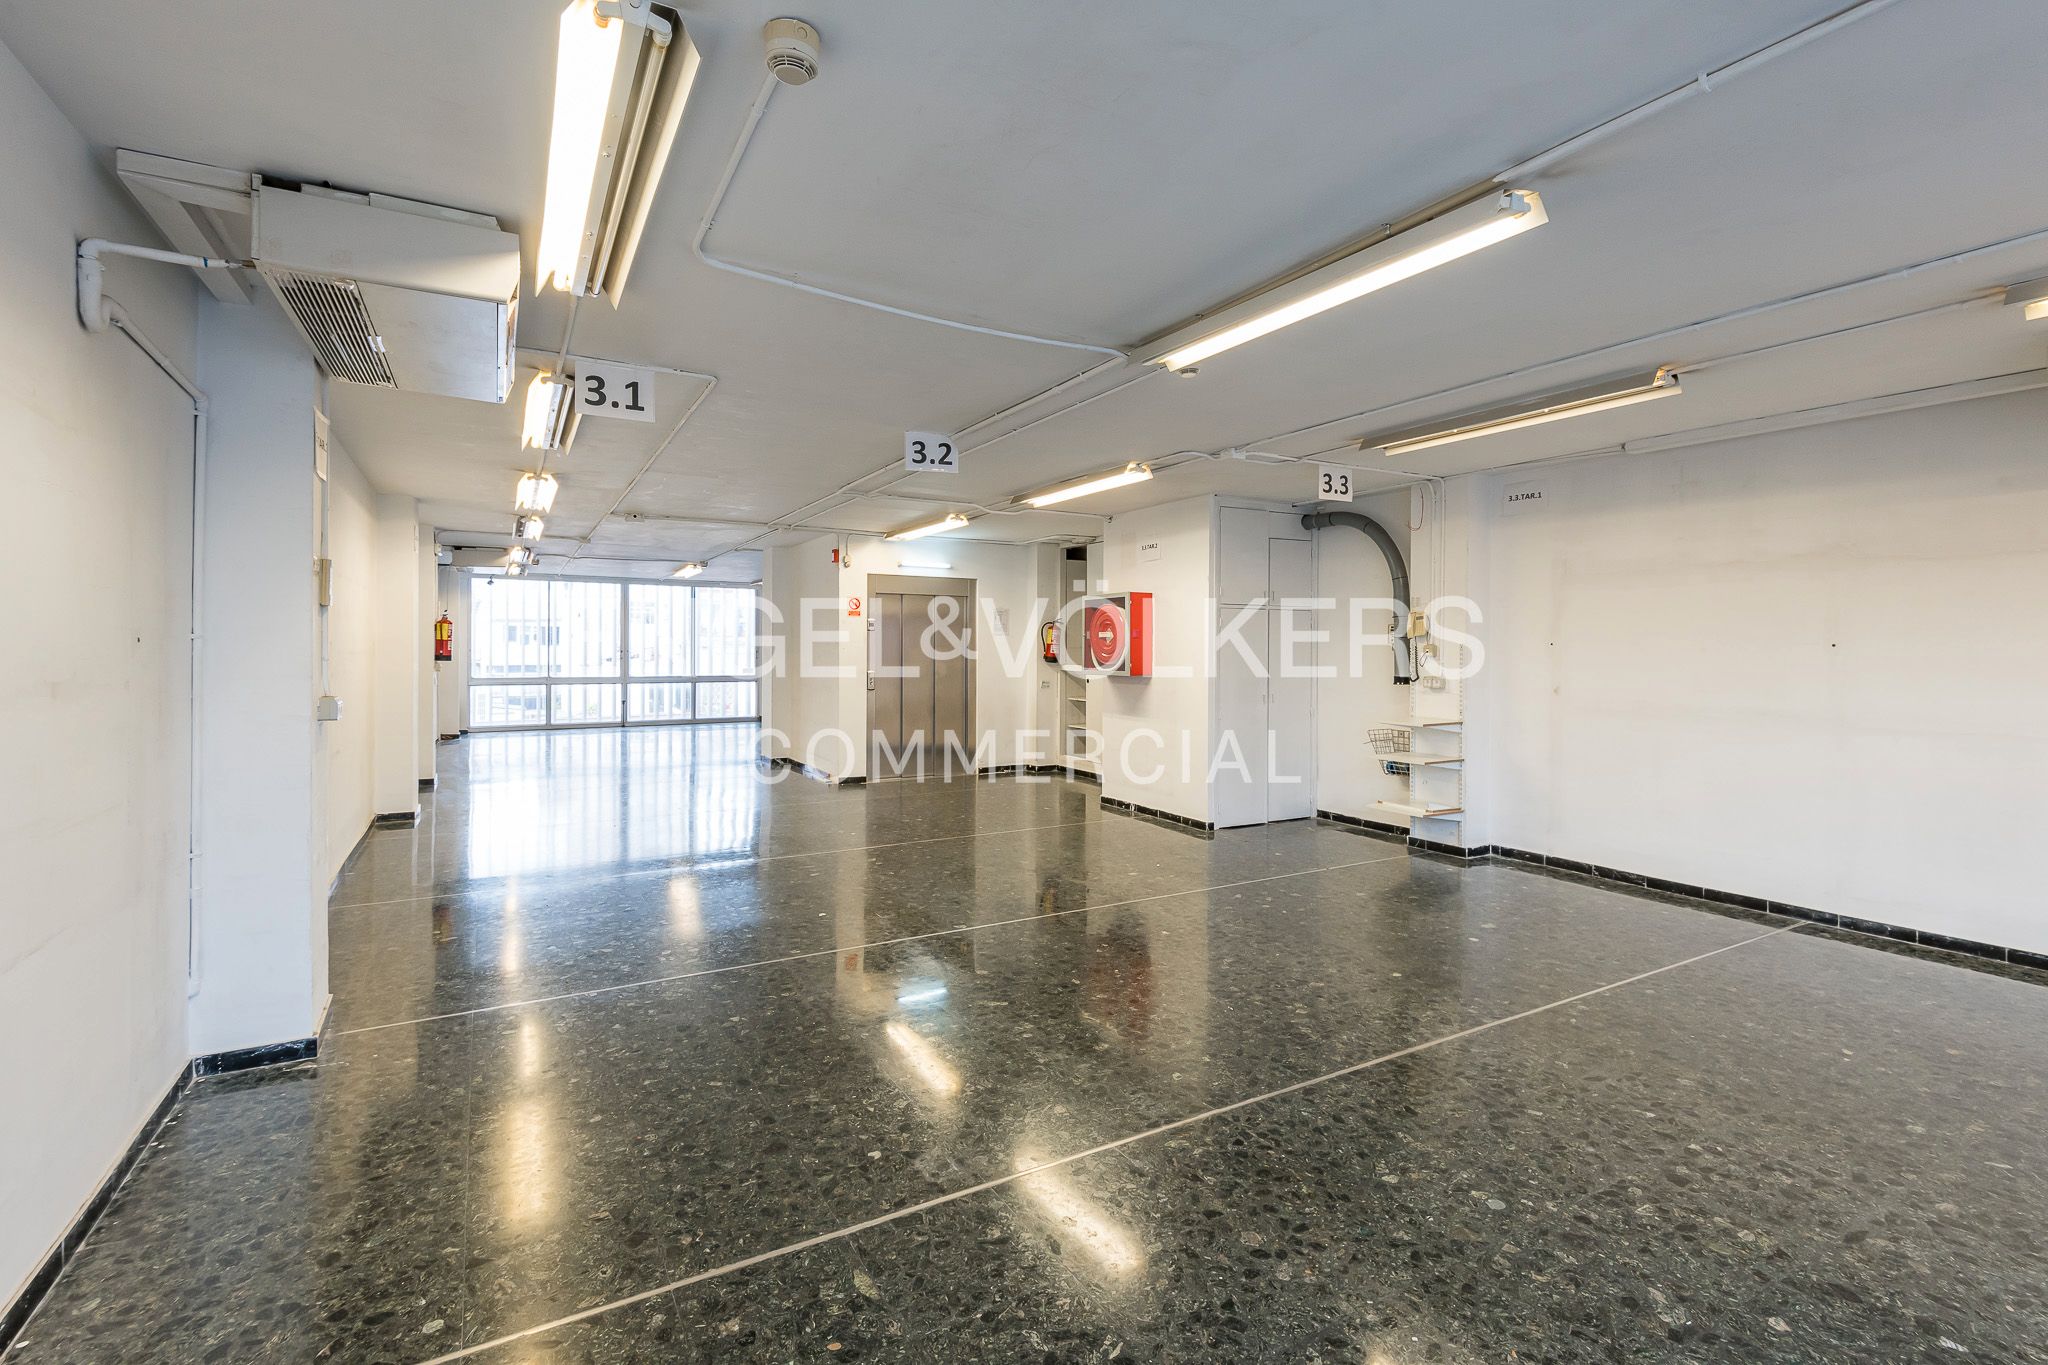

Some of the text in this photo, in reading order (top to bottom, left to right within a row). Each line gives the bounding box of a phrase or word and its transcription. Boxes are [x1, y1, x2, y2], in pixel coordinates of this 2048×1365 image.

[584, 375, 645, 411] 3.1
[911, 440, 953, 466] 3.2
[1322, 473, 1349, 495] 3.3
[1508, 491, 1542, 502] 3.3.TAR.1
